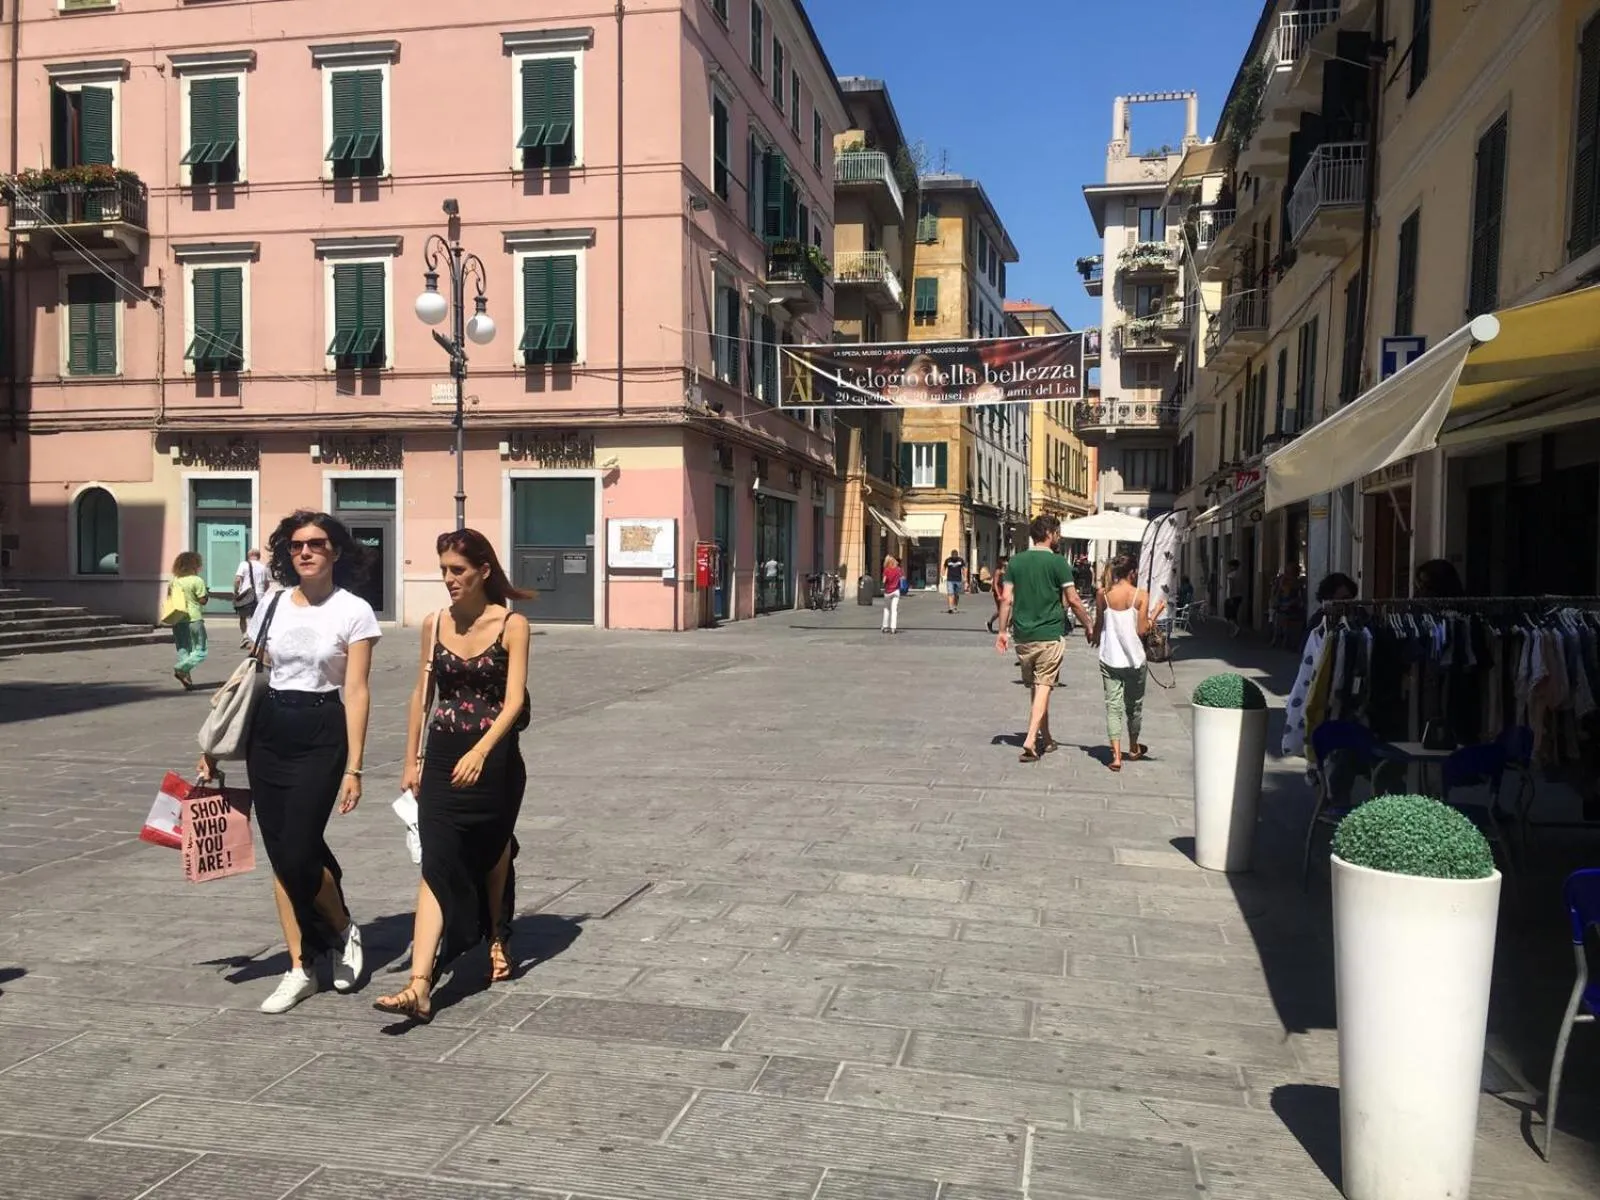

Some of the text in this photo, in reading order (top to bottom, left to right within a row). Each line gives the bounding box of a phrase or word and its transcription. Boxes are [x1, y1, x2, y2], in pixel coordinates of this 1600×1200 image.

[835, 360, 1076, 393] L'elogio della bellezza
[835, 391, 849, 403] 20
[1006, 387, 1032, 397] anni
[1035, 384, 1053, 395] del
[1056, 382, 1076, 395] Lia
[190, 798, 231, 820] SHOW
[193, 817, 227, 838] WHO
[196, 835, 223, 855] YOU
